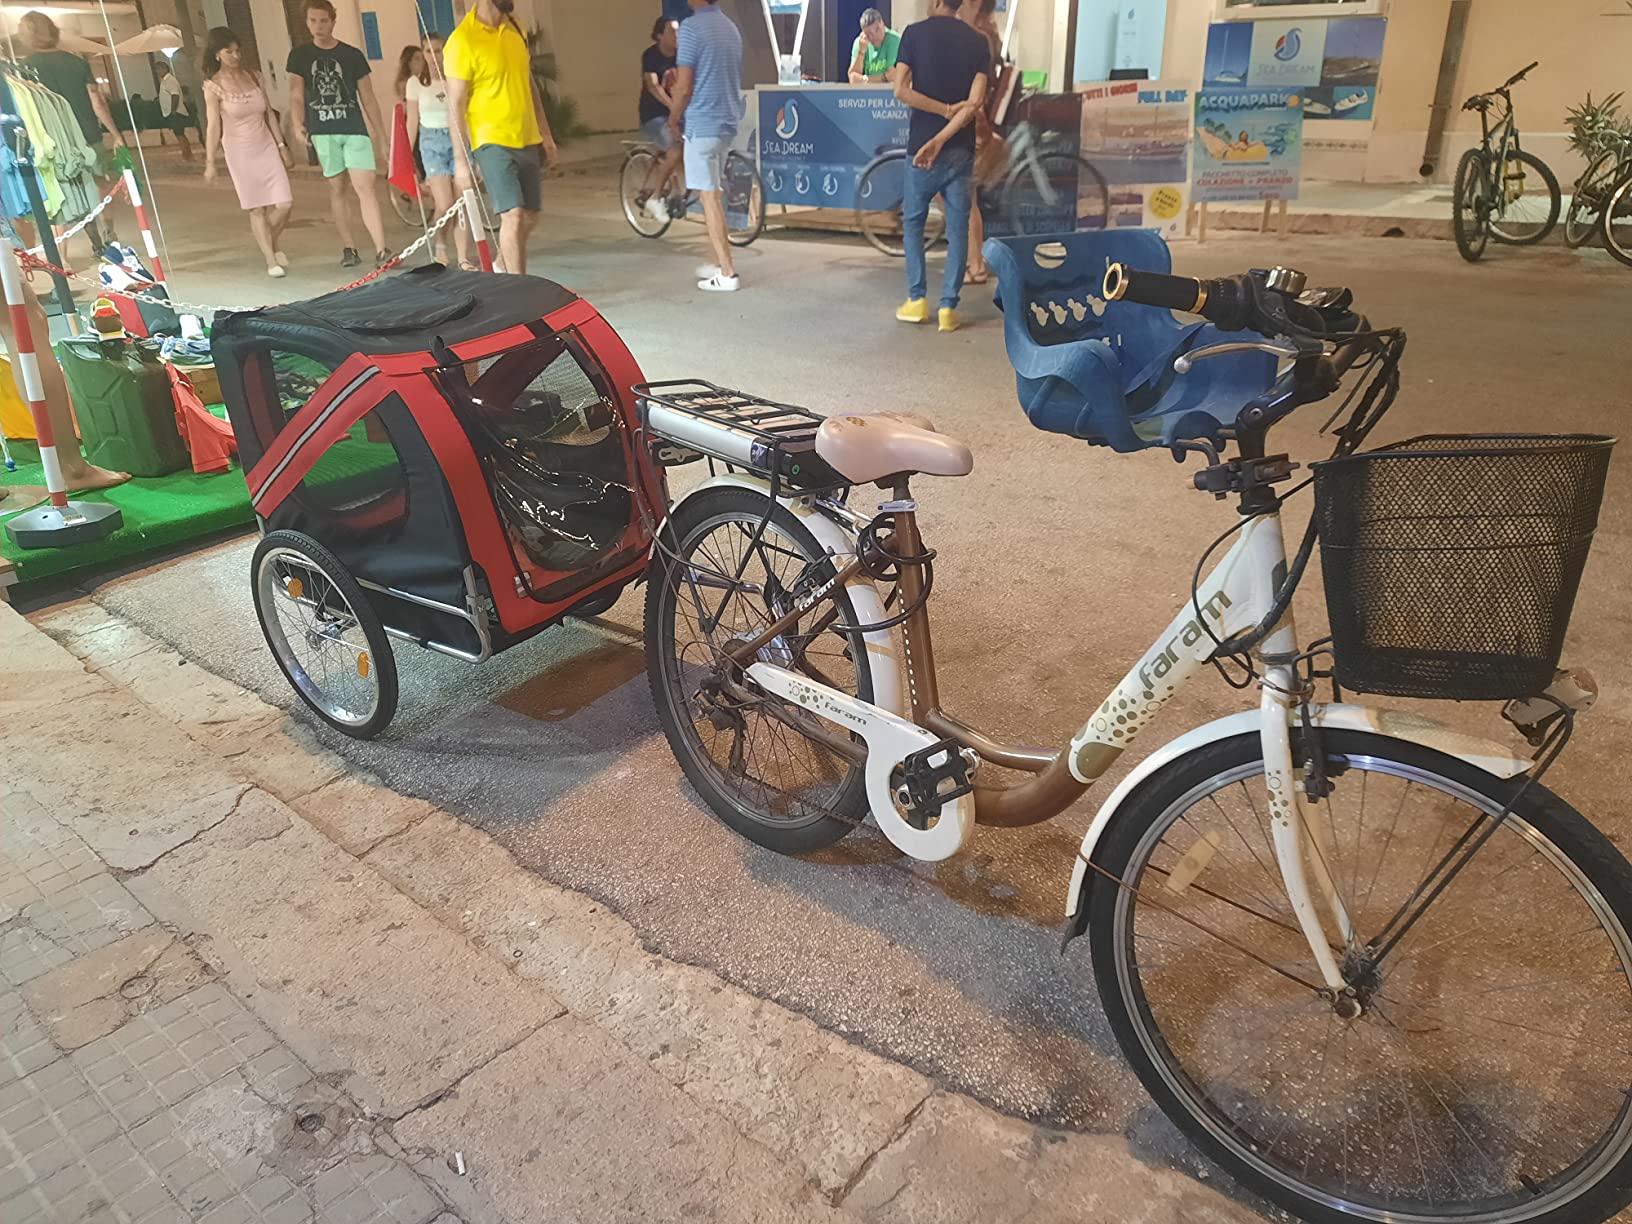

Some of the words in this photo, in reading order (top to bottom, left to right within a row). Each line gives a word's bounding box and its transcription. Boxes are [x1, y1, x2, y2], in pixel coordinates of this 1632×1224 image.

[838, 98, 866, 108] SERVIZI
[868, 98, 883, 108] PER
[885, 98, 895, 108] LA
[1200, 93, 1289, 109] ACQUAPARK
[871, 110, 908, 119] VACANZA
[762, 140, 780, 154] SEA
[781, 141, 814, 155] DREAM
[799, 578, 835, 612] faram
[1139, 590, 1232, 690] faram
[825, 702, 867, 725] faram
